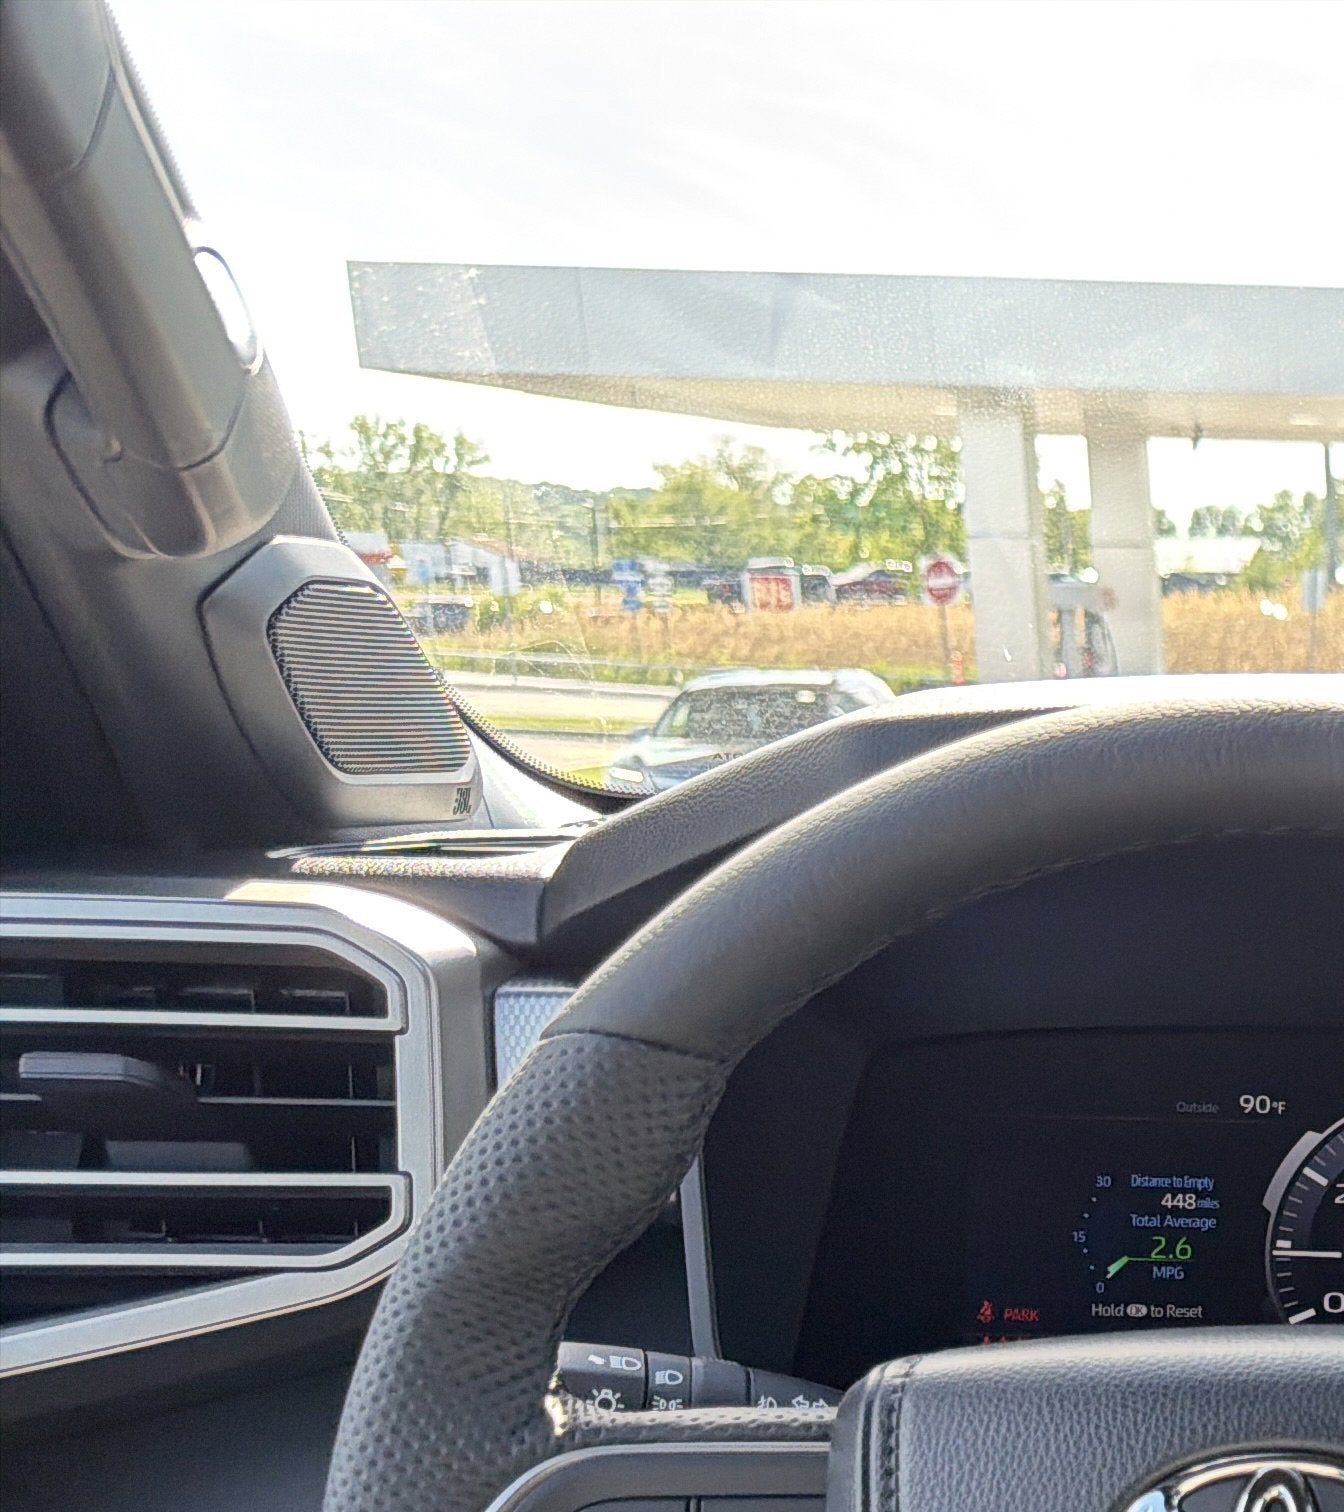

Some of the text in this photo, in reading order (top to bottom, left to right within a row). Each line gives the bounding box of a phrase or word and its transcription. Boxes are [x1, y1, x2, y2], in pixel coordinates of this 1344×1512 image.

[1176, 1101, 1220, 1115] Outside
[1095, 1176, 1112, 1188] 30
[1131, 1174, 1214, 1190] Distance to Empty
[1161, 1193, 1197, 1210] 448
[1130, 1215, 1217, 1231] Total Average
[1072, 1231, 1086, 1243] 15
[1150, 1237, 1192, 1260] 2.6
[1152, 1266, 1184, 1280] MPG
[1004, 1308, 1040, 1322] PARK
[1091, 1304, 1124, 1318] Hold
[1150, 1305, 1164, 1318] to
[1166, 1305, 1203, 1318] Reset
